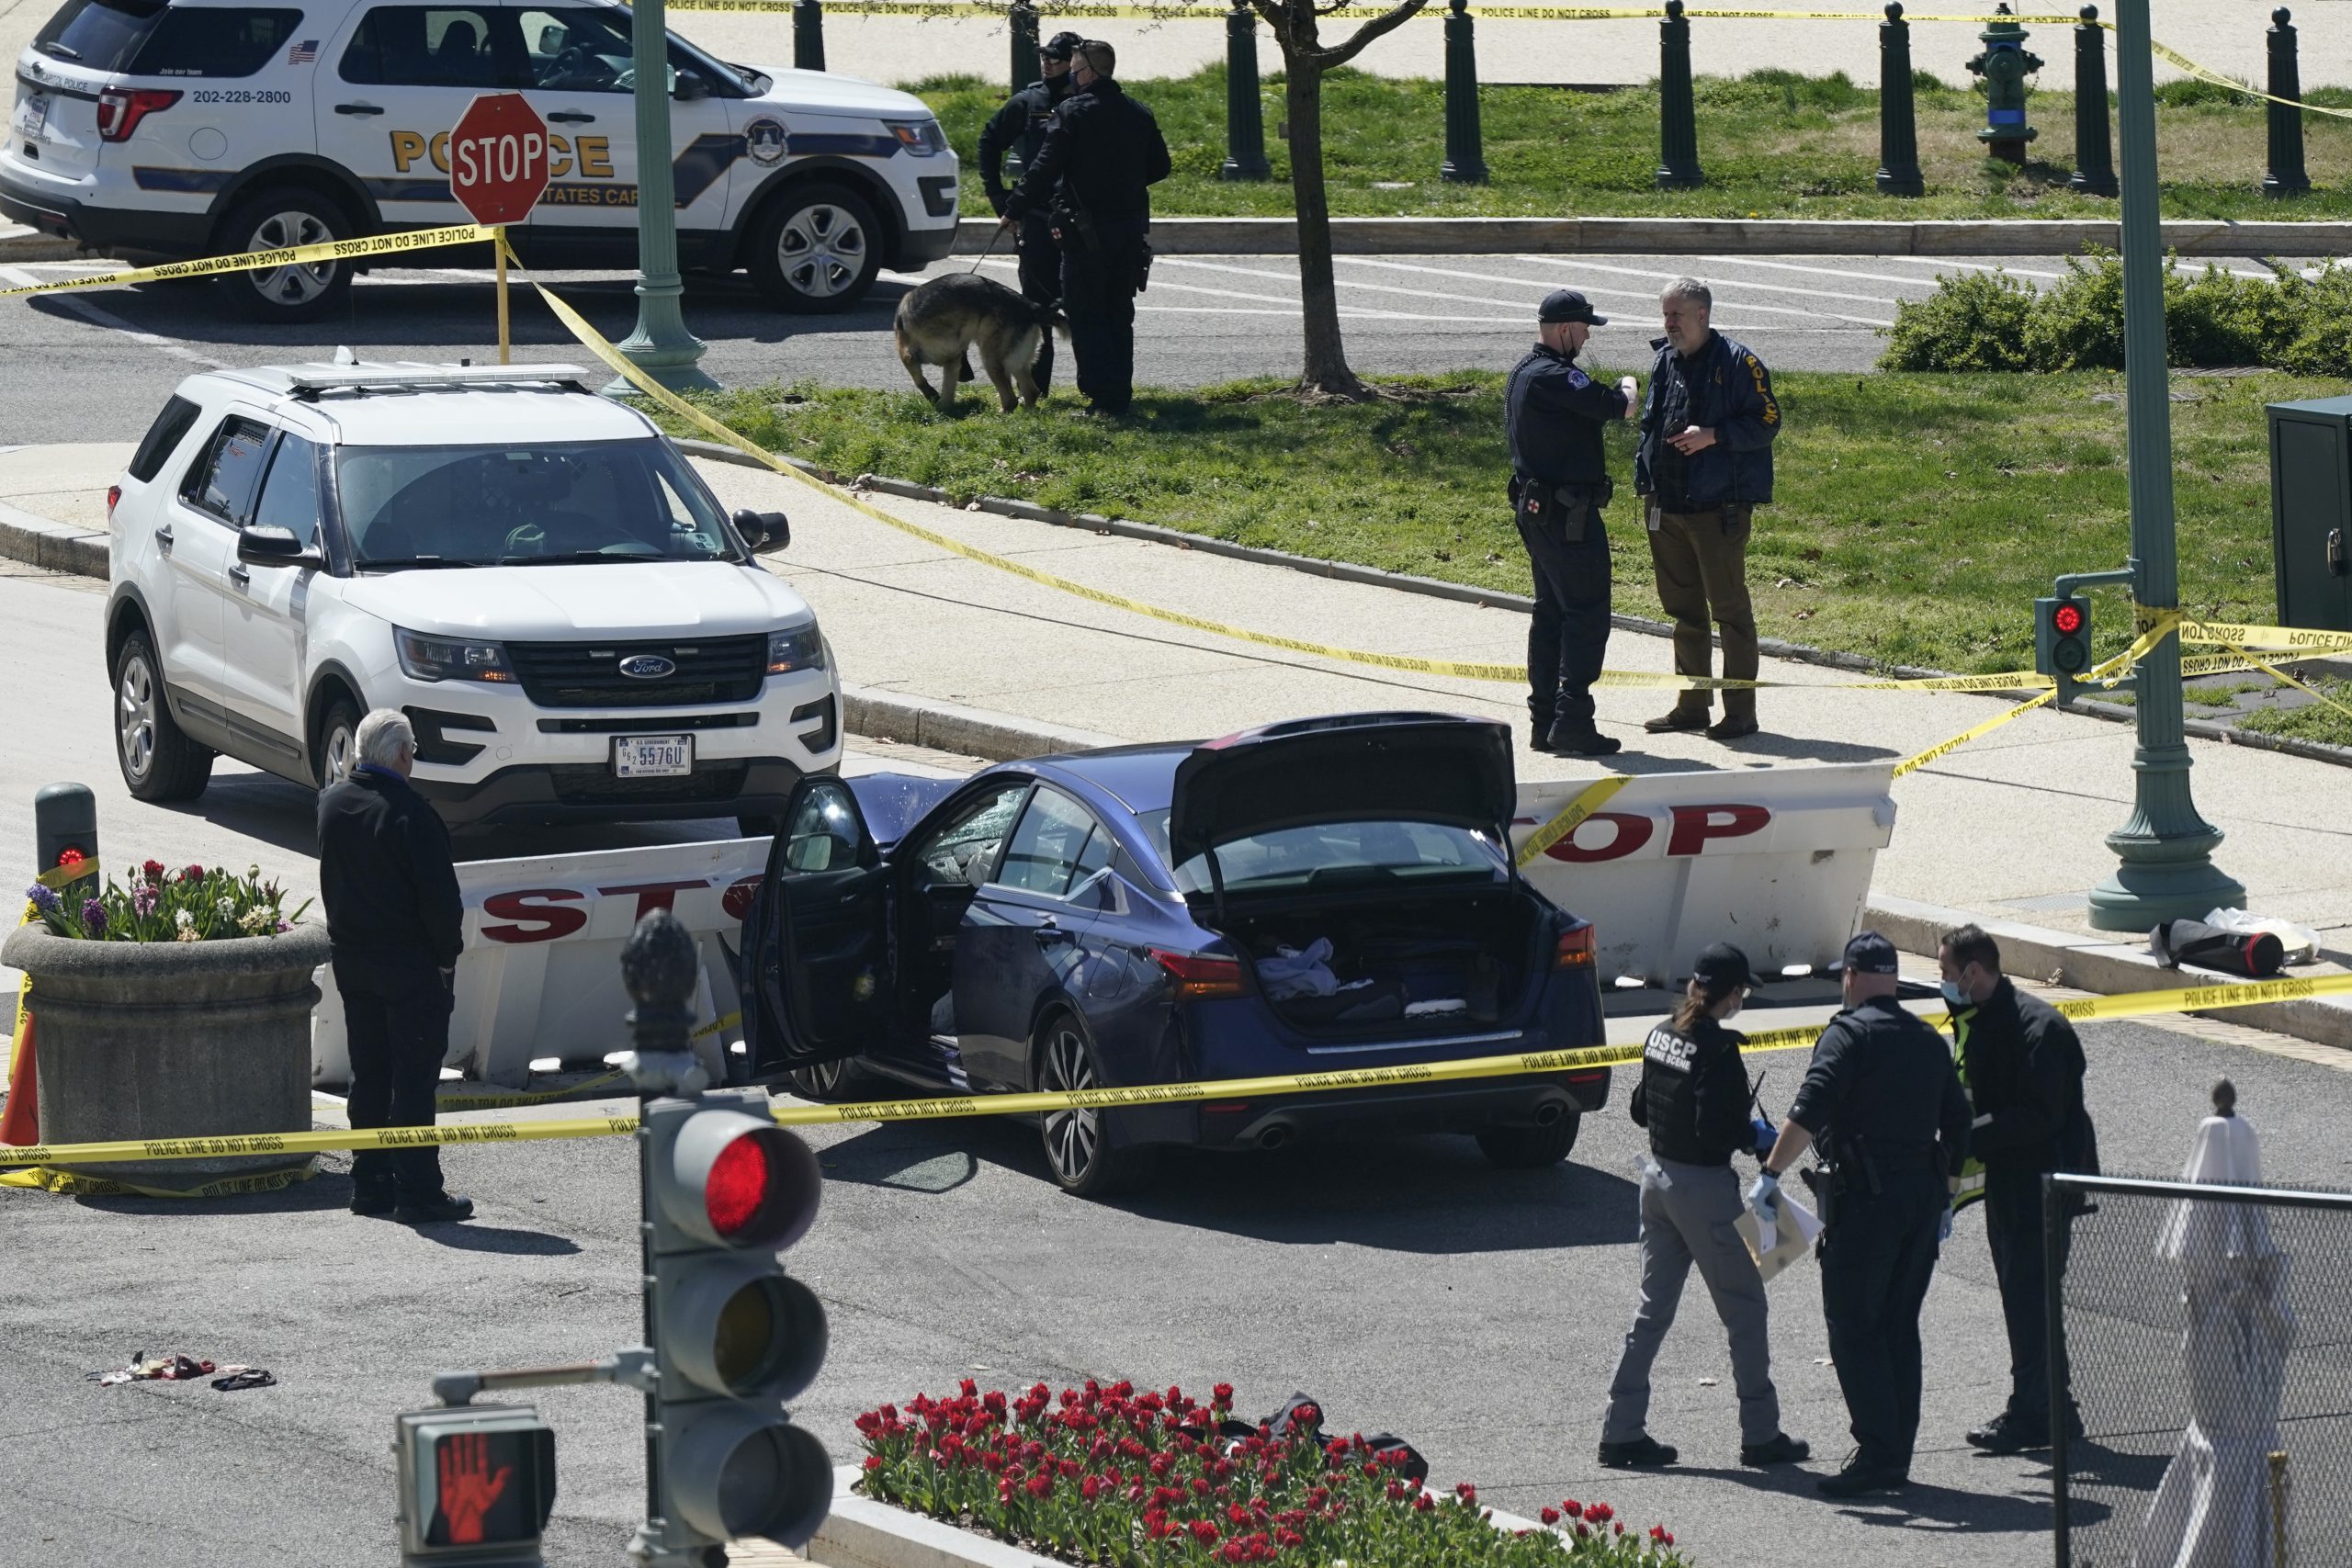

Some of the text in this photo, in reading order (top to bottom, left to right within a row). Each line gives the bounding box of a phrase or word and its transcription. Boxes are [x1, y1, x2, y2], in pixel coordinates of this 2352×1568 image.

[664, 1, 790, 12] POLICE LINE DO NOT CROSS
[825, 3, 858, 13] POLICE
[885, 4, 898, 14] DO
[900, 5, 919, 14] NOT
[1353, 8, 1374, 17] LINE
[1481, 8, 1611, 18] POLICE LINE DO NOT CROSS
[64, 78, 88, 91] POLICE
[193, 90, 291, 103] 202-228-2800
[390, 130, 614, 178] POCE
[458, 132, 543, 186] STOP
[334, 227, 475, 255] POLICE LINE DO NOT CROSS
[153, 249, 296, 276] POLICE LINE DO NOT CROSS
[1745, 355, 1779, 424] POLICE
[634, 660, 663, 672] Ford
[2183, 660, 2211, 673] CROSS
[2211, 658, 2230, 671] NOT
[2233, 655, 2245, 668] DO
[1964, 679, 1977, 689] DO
[1977, 677, 1995, 688] LINE
[1995, 675, 2023, 687] POLICE
[639, 746, 682, 765] 5576U
[2185, 980, 2315, 1007] POLICE LINE DO NOT CROSS
[2063, 1001, 2096, 1019] CROSS
[1648, 1029, 1698, 1059] USCP
[1781, 1030, 1803, 1045] LINE
[1805, 1028, 1819, 1044] DO
[1522, 1045, 1645, 1069] POLICE LINE DO NOT CROS
[1645, 1044, 1692, 1070] CRIME SCENE
[1295, 1066, 1431, 1088] POLICE LINE DO NOT CROSS
[1067, 1085, 1204, 1105] POLICE LINE DO NOT CROSS
[838, 1100, 977, 1120] POLICE LINE DO NOT CROSS
[609, 1118, 641, 1133] POLIC
[377, 1124, 516, 1145] POLICE LINE DO NOT CROSS
[144, 1136, 285, 1156] POLICE LINE DO NOT CROSS
[0, 1148, 51, 1162] OT CROSS
[62, 1176, 74, 1190] DO
[74, 1179, 88, 1193] NOT
[89, 1180, 120, 1193] CROSS
[234, 1178, 252, 1192] LINE
[266, 1174, 286, 1190] NOT
